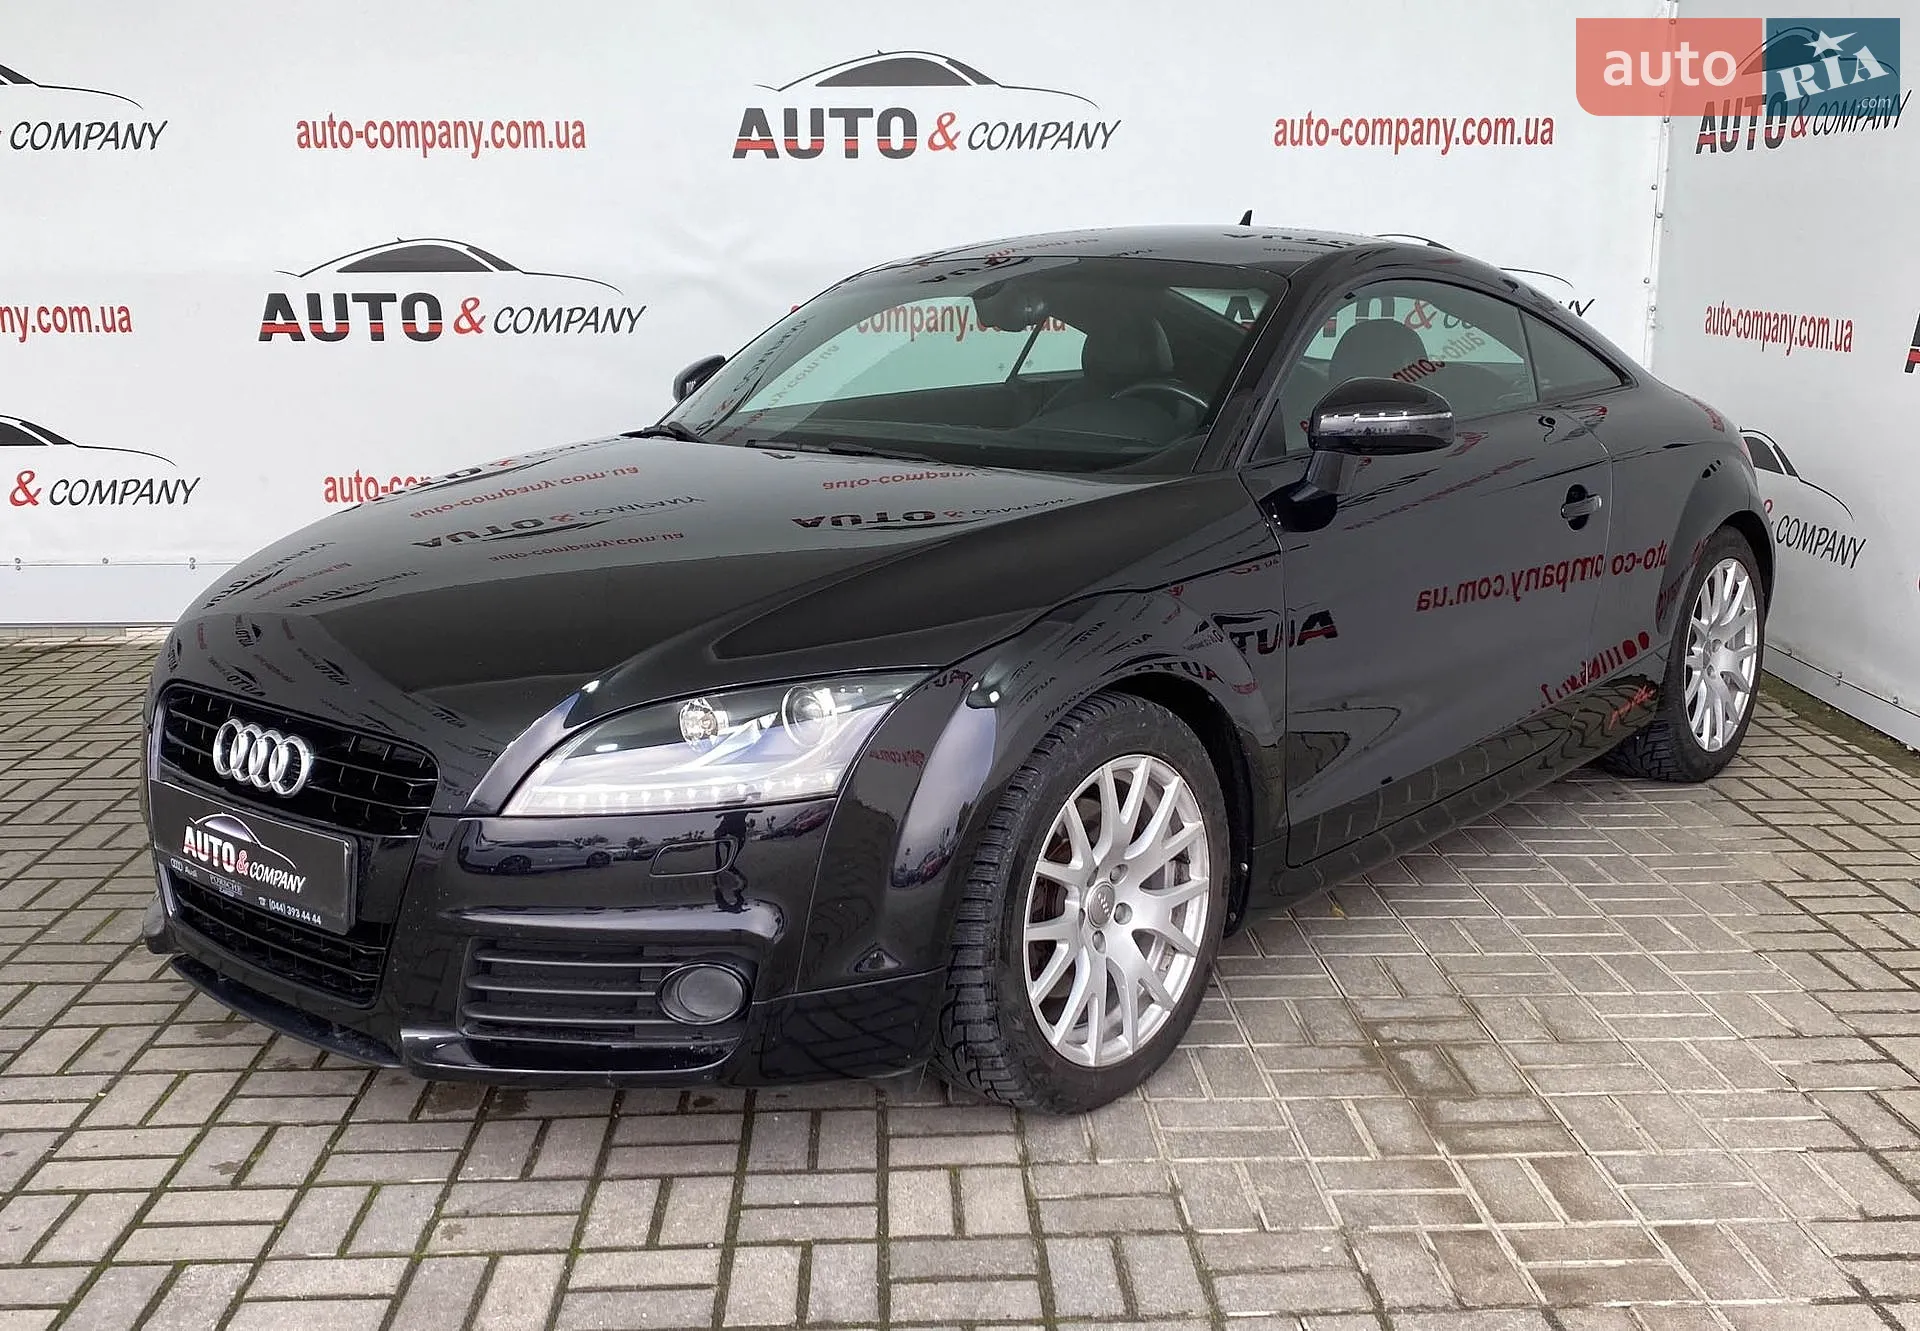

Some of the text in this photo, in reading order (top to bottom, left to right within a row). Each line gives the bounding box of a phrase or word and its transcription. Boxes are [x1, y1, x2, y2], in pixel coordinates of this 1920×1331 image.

[9, 119, 169, 151] COMPANY
[296, 111, 586, 159] auto-company.com.ua
[732, 107, 1122, 160] AUTO & COMPANY
[1273, 110, 1554, 156] auto-company.com.ua
[1695, 91, 1789, 156] AUTO
[1812, 88, 1912, 136] COMPANY
[258, 292, 647, 343] AUTO & COMPANY
[1705, 300, 1853, 357] auto-company.com.ua
[9, 470, 201, 507] & COMPANY
[1776, 515, 1867, 569] COMPANY
[182, 825, 307, 894] AUTO & COMPANY
[268, 898, 322, 926] (044) 393 44 44
